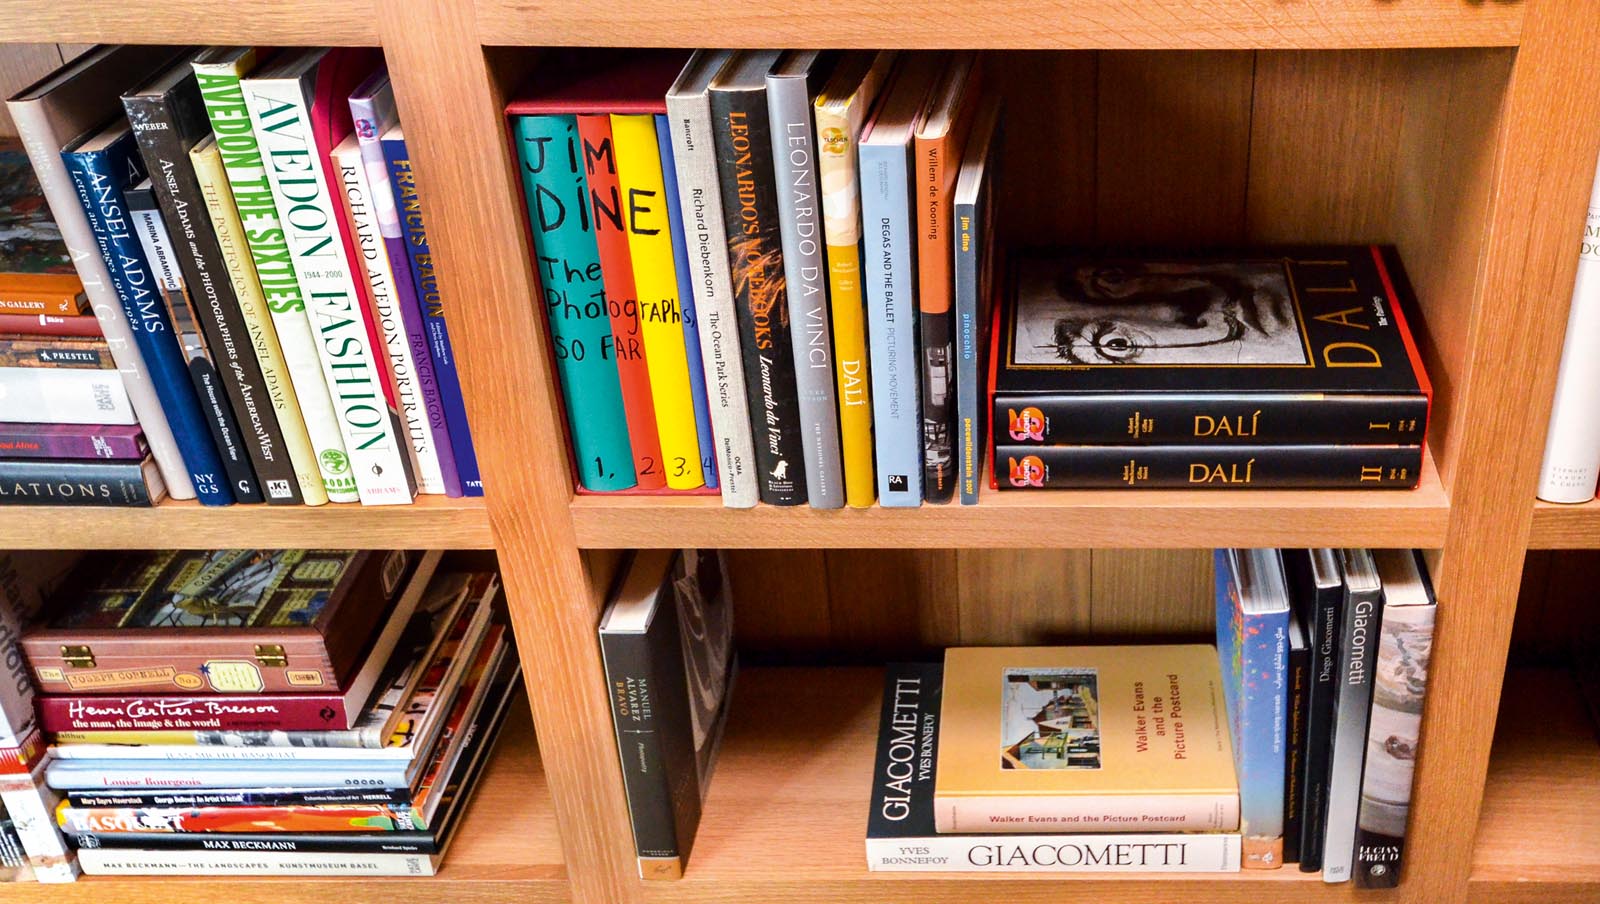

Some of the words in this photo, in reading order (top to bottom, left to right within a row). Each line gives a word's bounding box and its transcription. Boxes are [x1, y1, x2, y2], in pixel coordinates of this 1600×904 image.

[134, 121, 169, 132] WEBER
[197, 72, 266, 169] AVEDON
[683, 119, 694, 151] Bancroft
[127, 157, 141, 184] A
[252, 91, 338, 259] AVEDON
[729, 111, 761, 235] LEONARDO'S
[928, 147, 939, 183] Willem
[232, 175, 279, 228] THE
[787, 122, 817, 256] LEONARDO
[929, 184, 939, 197] de
[72, 170, 92, 210] Letters
[88, 211, 101, 233] and
[97, 232, 117, 274] Images
[692, 188, 708, 231] Richard
[928, 199, 940, 240] Kooning
[960, 215, 970, 231] jim
[142, 212, 159, 246] MARINA
[392, 159, 425, 247] FRANCIS
[413, 252, 445, 319] BACON
[881, 217, 891, 249] DEGAS
[961, 233, 970, 252] dine
[88, 170, 130, 247] ANSEL
[119, 254, 165, 333] ADAMS
[698, 232, 715, 298] Diebenkorn
[883, 250, 892, 270] AND
[247, 226, 304, 313] SIXTIES
[539, 256, 603, 284] The
[801, 266, 820, 297] DA
[884, 271, 893, 288] THE
[9, 301, 45, 309] GALLERY
[160, 158, 181, 197] ANSEL
[174, 199, 196, 240] ADAMS
[200, 271, 238, 364] PHOTOGRAPHERS
[239, 382, 266, 436] AMERICAN
[257, 433, 274, 462] WEST
[203, 183, 222, 213] THE
[214, 216, 250, 299] PORTFOLIOS
[242, 301, 256, 319] OF
[249, 323, 271, 364] ANSEL
[261, 366, 286, 411] ADAMS
[340, 164, 378, 261] RICHARD
[368, 269, 401, 346] AVEDON
[389, 353, 429, 454] PORTRAITS
[885, 290, 895, 324] BALLET
[69, 247, 141, 380] ATGET
[709, 311, 719, 329] The
[600, 334, 643, 361] FAR
[711, 328, 722, 359] Ocean
[806, 306, 827, 369] VINCI
[886, 327, 897, 373] PICTURING
[962, 313, 972, 360] pinocchio
[52, 352, 95, 361] PRESTEL
[309, 288, 390, 453] FASHION
[715, 360, 727, 382] Park
[411, 332, 433, 381] FRANCIS
[423, 383, 444, 431] BACON
[718, 380, 729, 408] Series
[759, 354, 778, 410] Leonardo
[842, 360, 866, 407] DALÍ
[888, 374, 900, 420] MOVEMENT
[202, 373, 210, 385] The
[207, 384, 216, 404] House
[212, 403, 220, 416] with
[219, 427, 232, 450] Ocean
[227, 447, 238, 461] View
[765, 408, 778, 424] da
[1193, 410, 1262, 437] DALÍ
[766, 422, 783, 456] Vinci
[194, 473, 214, 484] NY
[734, 456, 743, 476] OCMA
[888, 475, 902, 484] RA
[1189, 458, 1256, 483] DALÍ
[199, 484, 219, 494] GS
[1321, 607, 1335, 656] Giacometti
[1348, 601, 1373, 686] Giacometti
[71, 673, 116, 685] JOSEPH
[118, 669, 171, 681] CORNELL
[1319, 657, 1334, 683] Diego
[69, 699, 124, 719] Henri
[616, 682, 628, 717] BRAVO
[626, 676, 641, 723] ALVAREZ
[638, 678, 652, 722] MANUEL
[1132, 681, 1145, 711] Evans
[1151, 696, 1163, 713] the
[1167, 674, 1183, 719] Postcard
[73, 719, 89, 728] the
[90, 719, 116, 730] man,
[116, 719, 133, 728] the
[133, 719, 163, 730] image
[164, 719, 174, 728] &
[175, 719, 191, 728] the
[192, 718, 221, 728] world
[920, 712, 935, 753] BONNEFOY
[1136, 714, 1149, 753] Walker
[1154, 716, 1166, 737] and
[883, 678, 921, 821] GIACOMETTI
[1173, 721, 1187, 760] Picture
[103, 776, 141, 786] Louise
[145, 777, 202, 788] Bourgeois
[918, 752, 931, 781] YVES
[80, 797, 96, 806] Mary
[989, 814, 1025, 823] Walker
[1028, 814, 1058, 823] Evans
[1061, 814, 1080, 823] and
[1082, 814, 1100, 823] the
[1103, 814, 1138, 823] Picture
[1142, 814, 1186, 823] Postcard
[203, 840, 230, 850] MAX
[233, 840, 297, 851] BECKMANN
[881, 856, 949, 865] BONNEFOY
[899, 846, 930, 856] YVES
[967, 843, 1188, 867] GIACOMETTI
